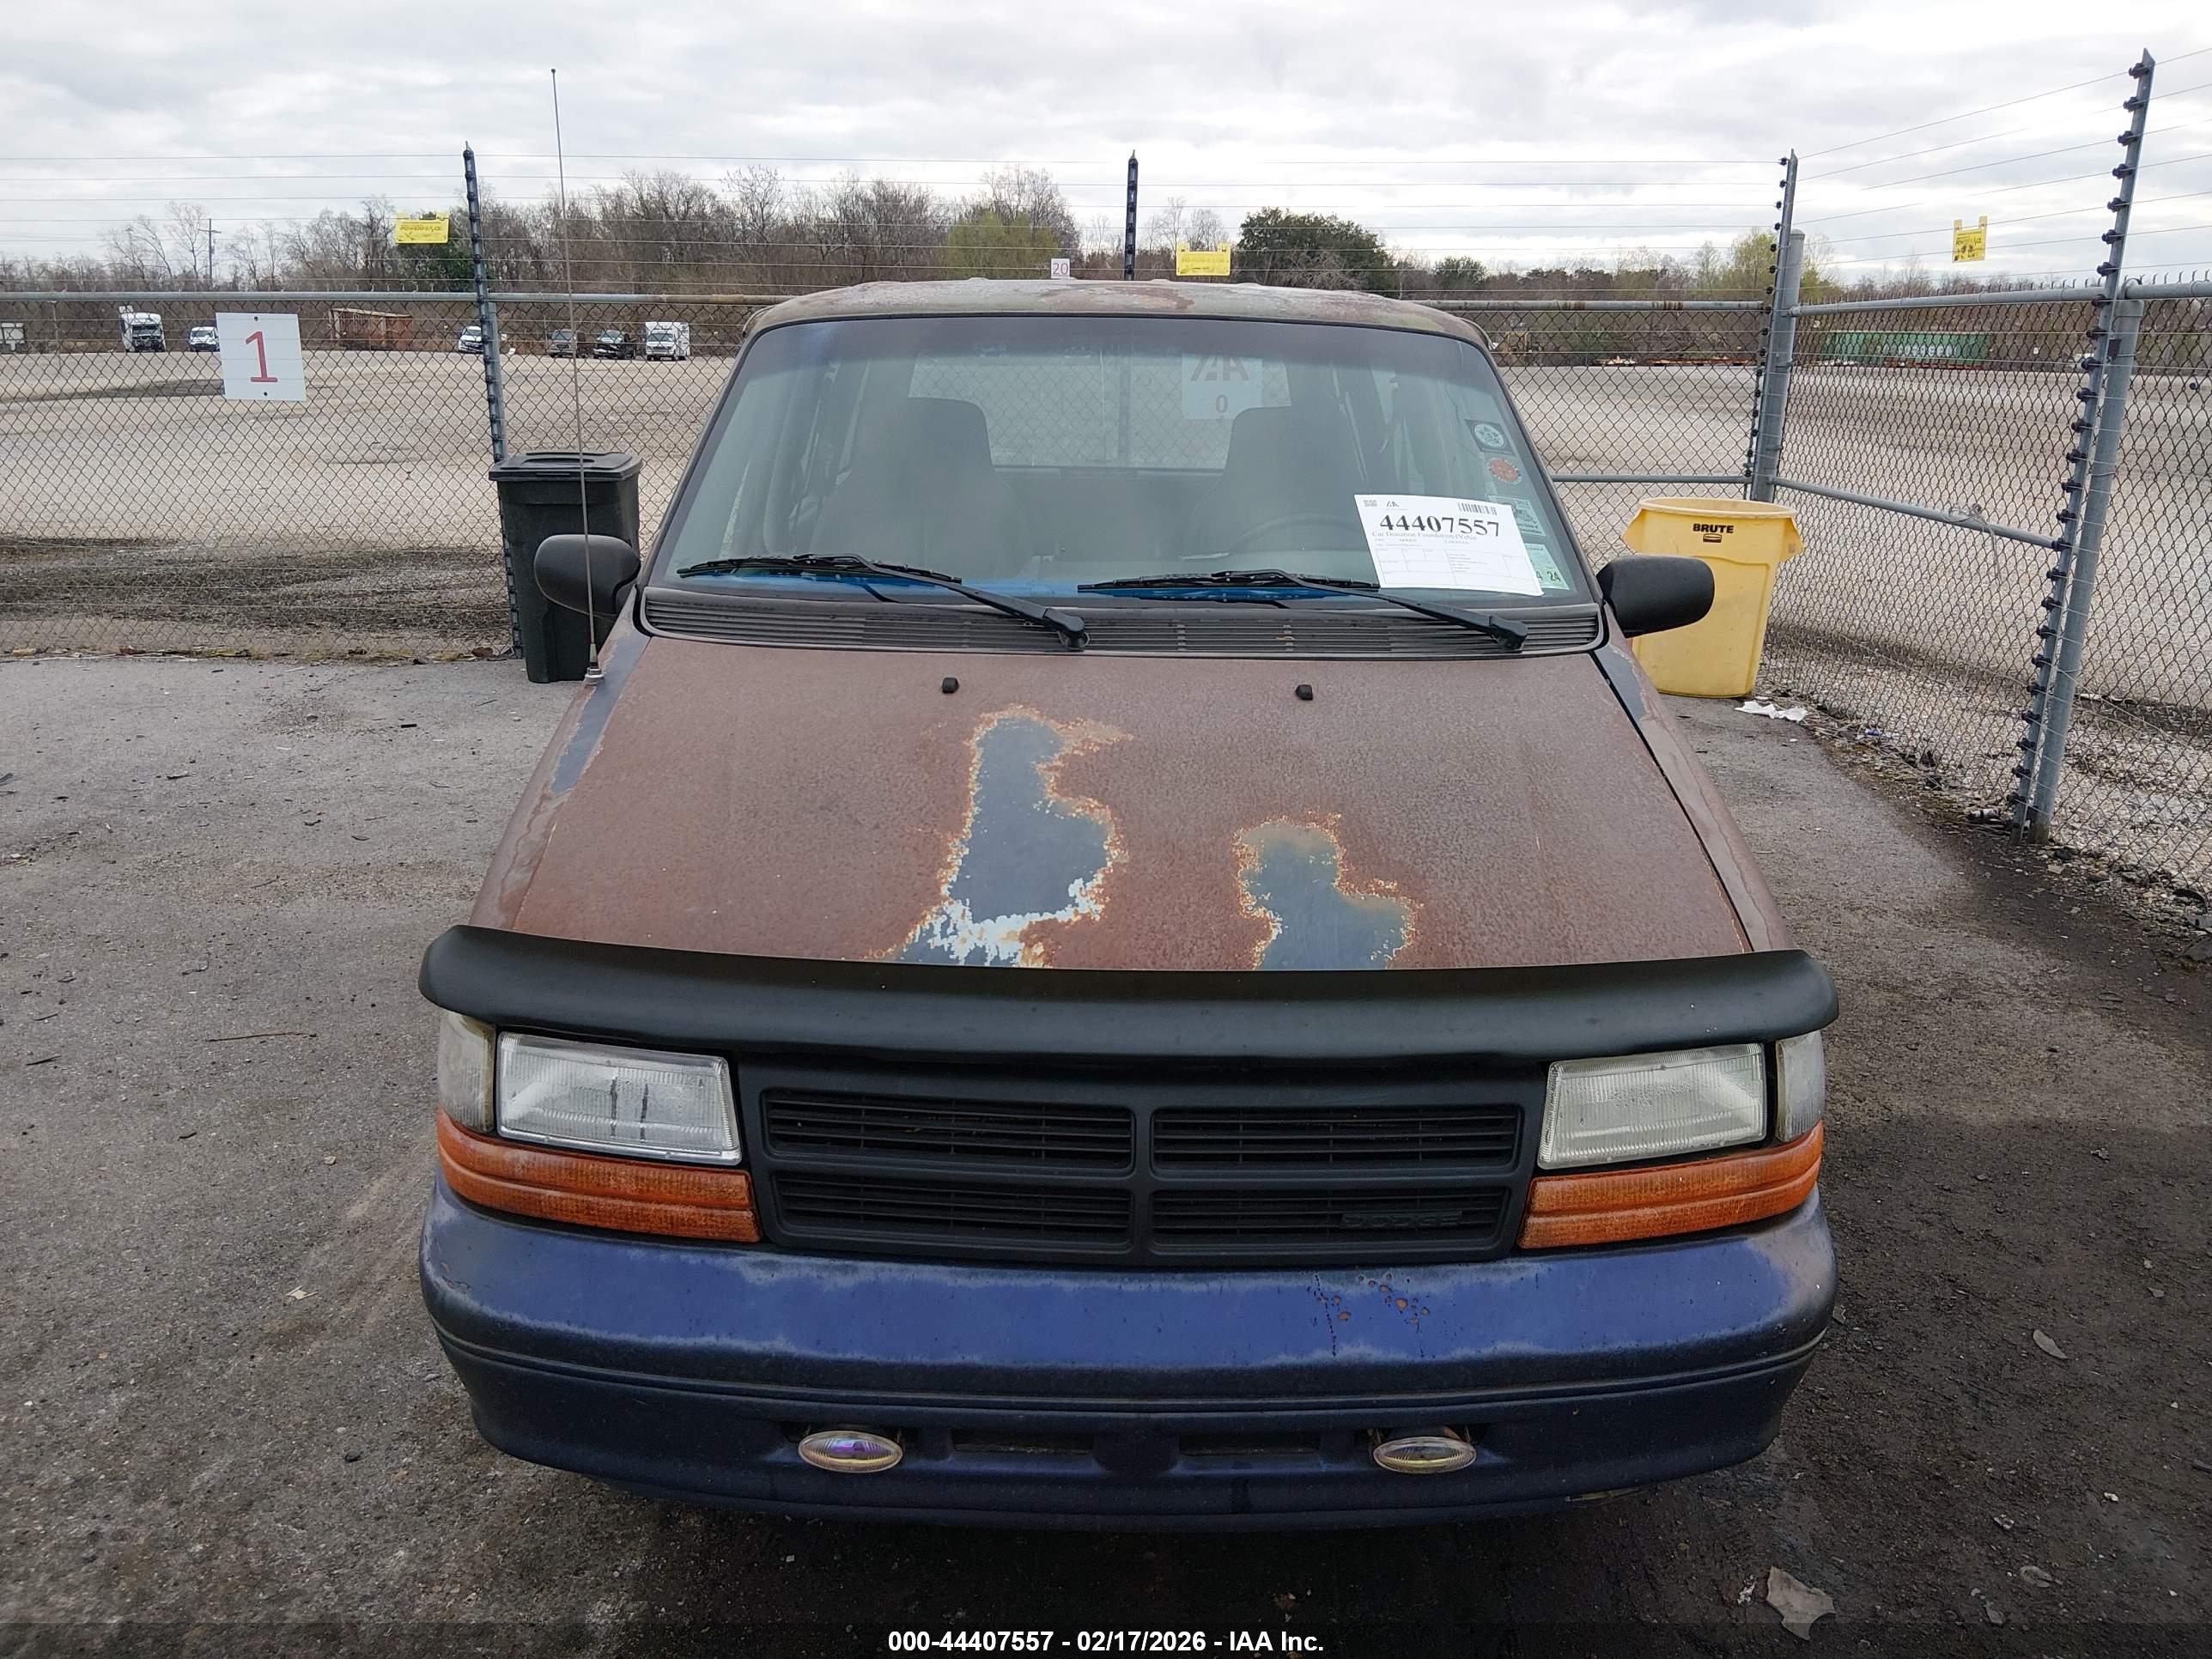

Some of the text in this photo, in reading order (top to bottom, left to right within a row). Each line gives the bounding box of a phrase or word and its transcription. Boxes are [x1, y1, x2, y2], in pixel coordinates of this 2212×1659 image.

[1053, 262, 1069, 275] 20
[246, 331, 278, 382] 1
[1380, 514, 1500, 537] 44407557
[1692, 523, 1735, 533] BRUTE
